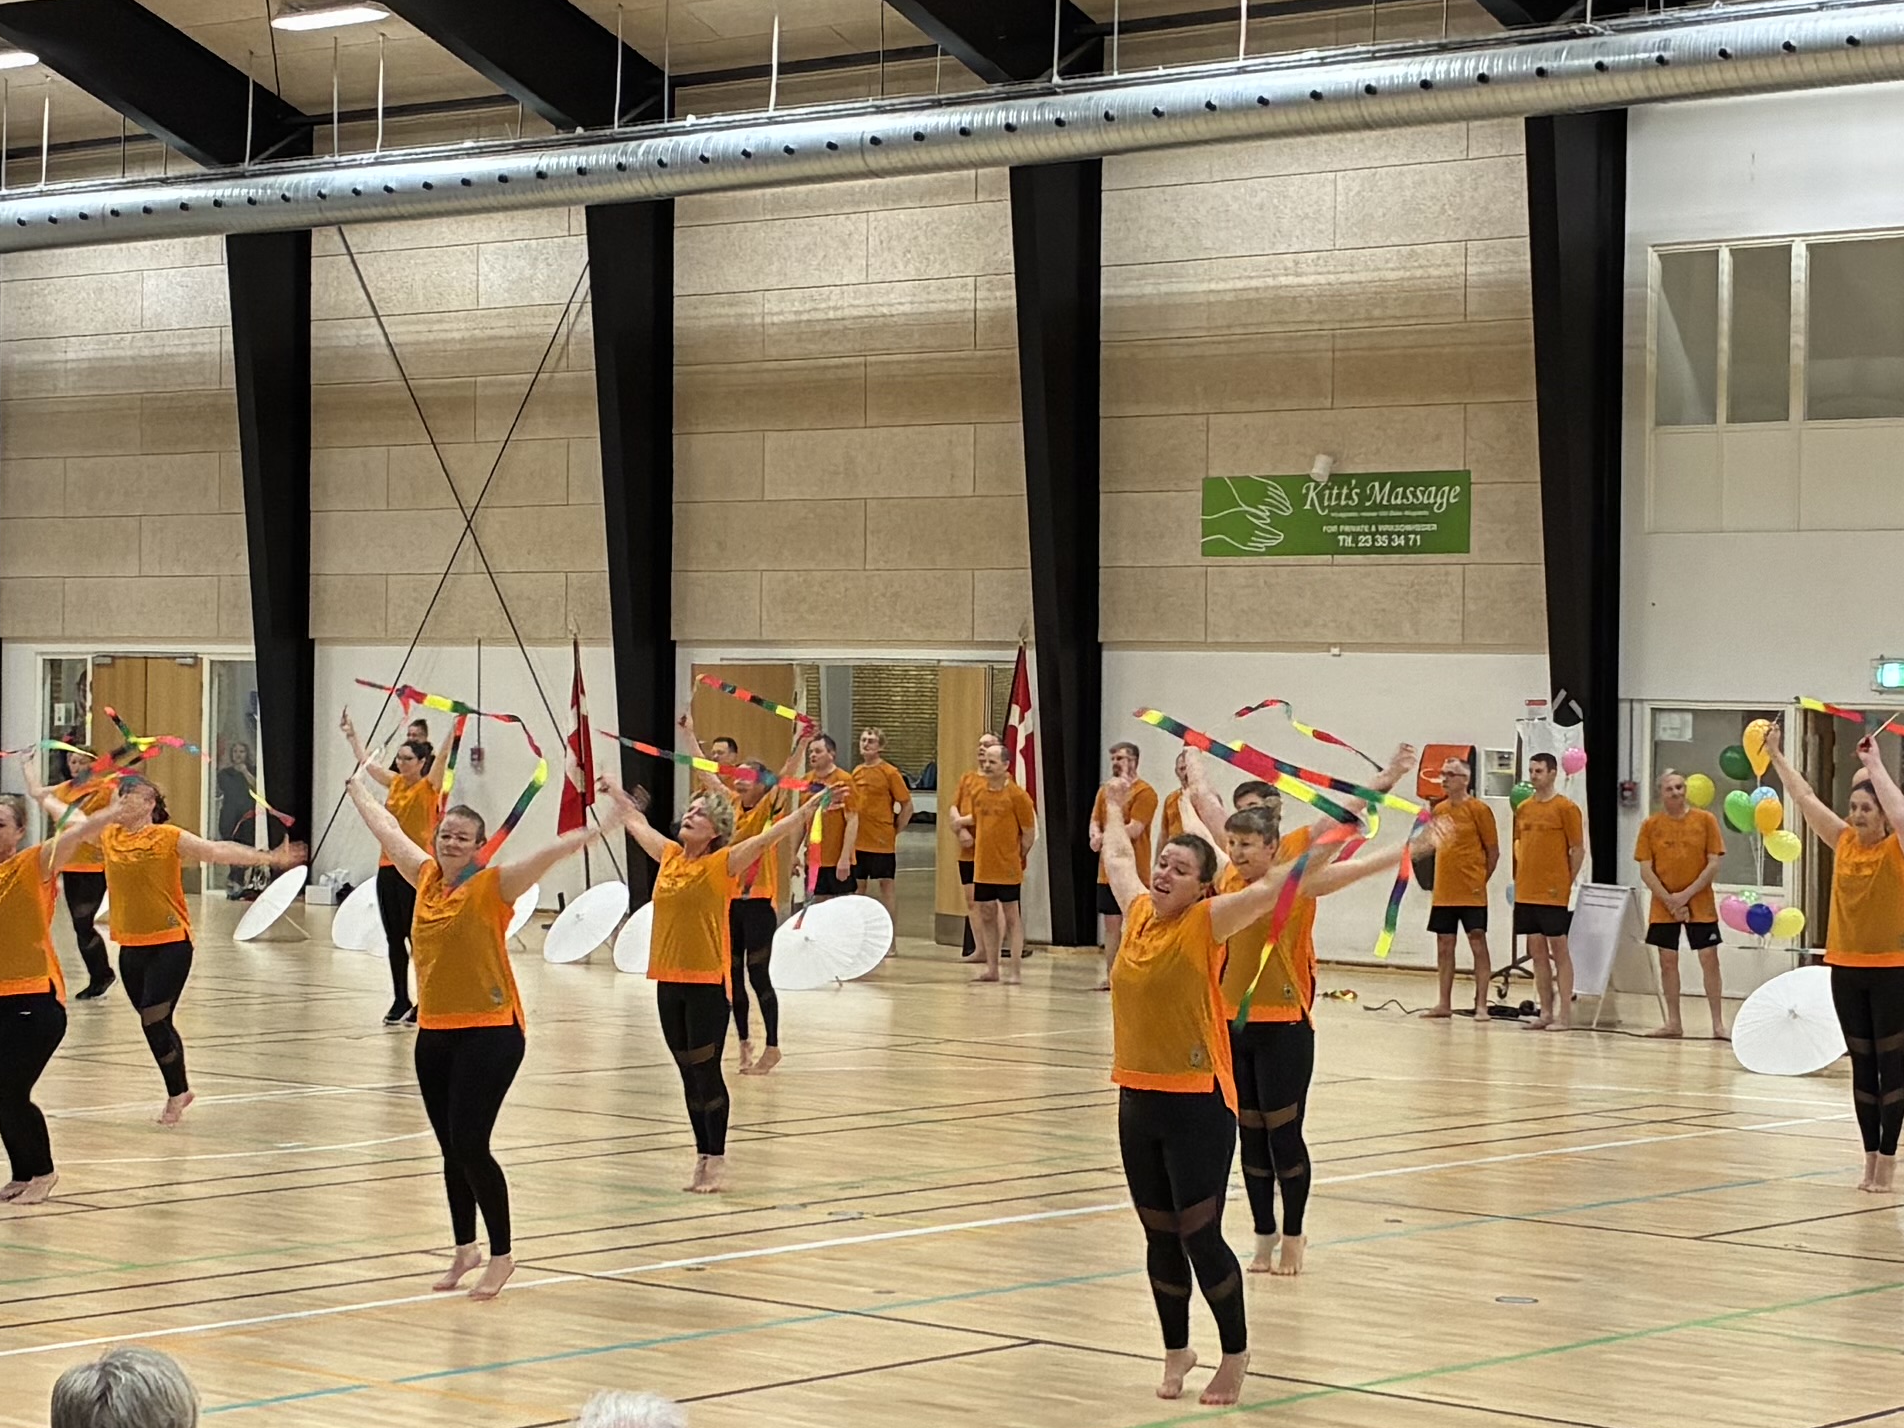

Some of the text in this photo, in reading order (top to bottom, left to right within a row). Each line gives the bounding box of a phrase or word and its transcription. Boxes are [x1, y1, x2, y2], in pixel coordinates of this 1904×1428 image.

[1302, 479, 1461, 516] Kitt's Massage
[1357, 534, 1373, 547] 23
[1374, 534, 1389, 547] 35
[1390, 534, 1405, 547] 34
[1407, 534, 1422, 547] 71
